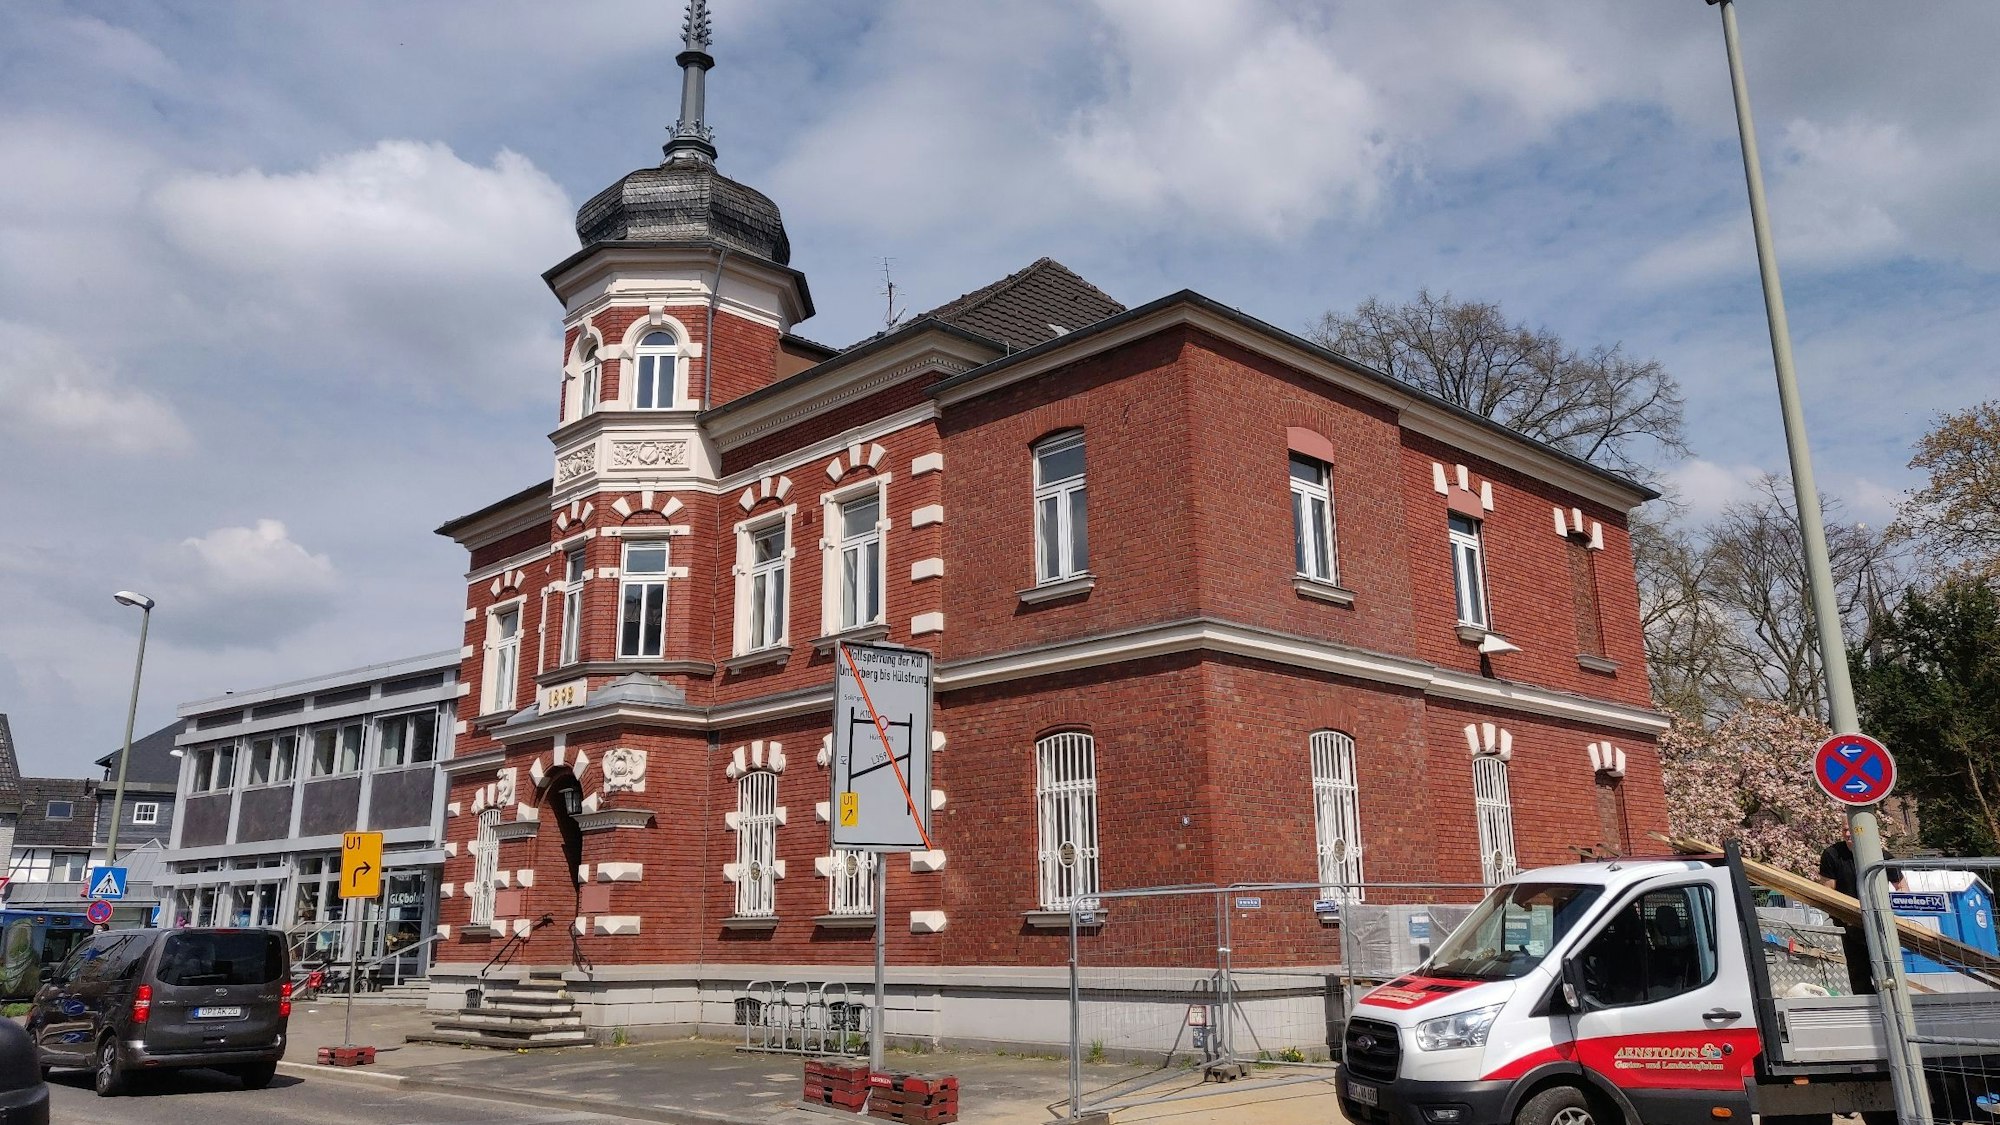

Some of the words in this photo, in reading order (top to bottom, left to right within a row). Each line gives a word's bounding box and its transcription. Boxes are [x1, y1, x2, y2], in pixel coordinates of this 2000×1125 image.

[897, 654, 910, 667] der
[911, 656, 923, 668] K10
[840, 664, 878, 682] Untrberg
[880, 669, 891, 681] bis
[860, 709, 872, 719] K10
[840, 755, 848, 766] K1
[843, 795, 853, 806] U1
[346, 836, 361, 850] U1
[1893, 896, 1942, 906] awekoFIX
